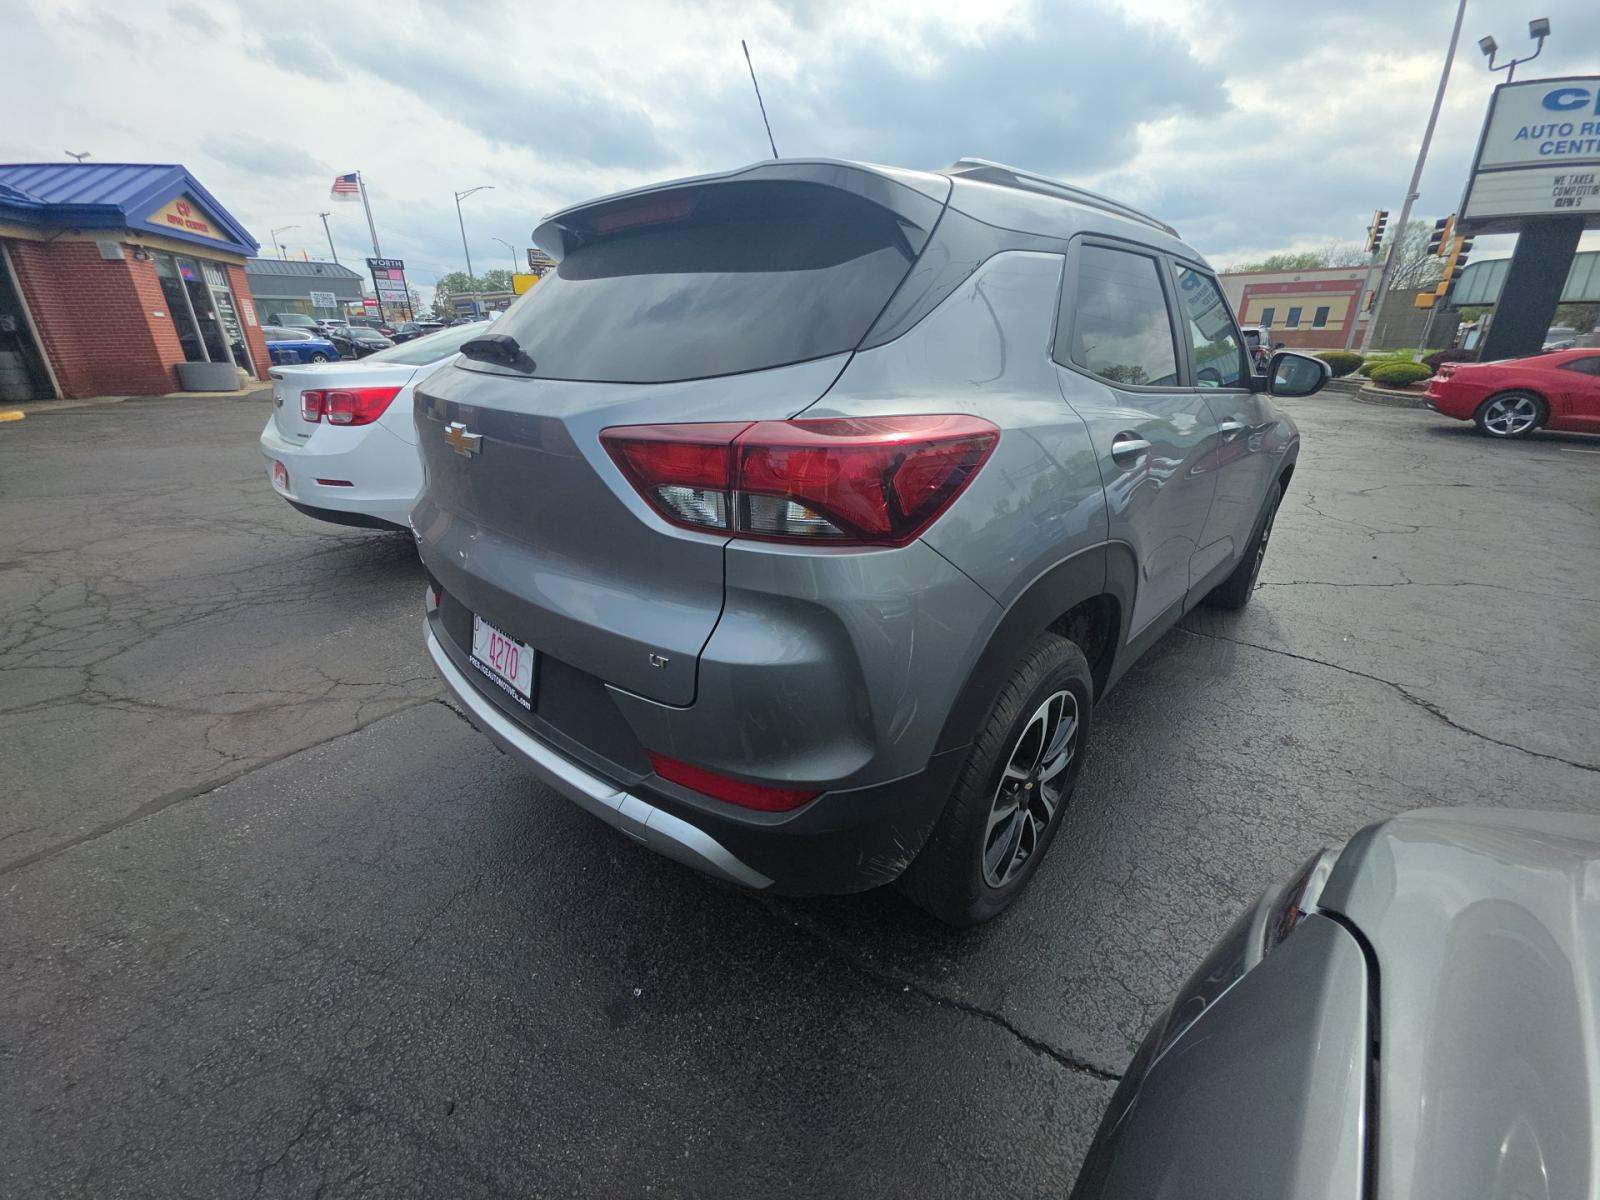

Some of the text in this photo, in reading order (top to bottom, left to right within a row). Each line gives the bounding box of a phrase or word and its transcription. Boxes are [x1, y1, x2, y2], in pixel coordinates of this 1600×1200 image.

[1513, 123, 1573, 140] AUTO
[1540, 140, 1600, 155] CENT
[371, 259, 402, 268] WORTH
[489, 632, 519, 680] 4270
[649, 653, 670, 668] LT
